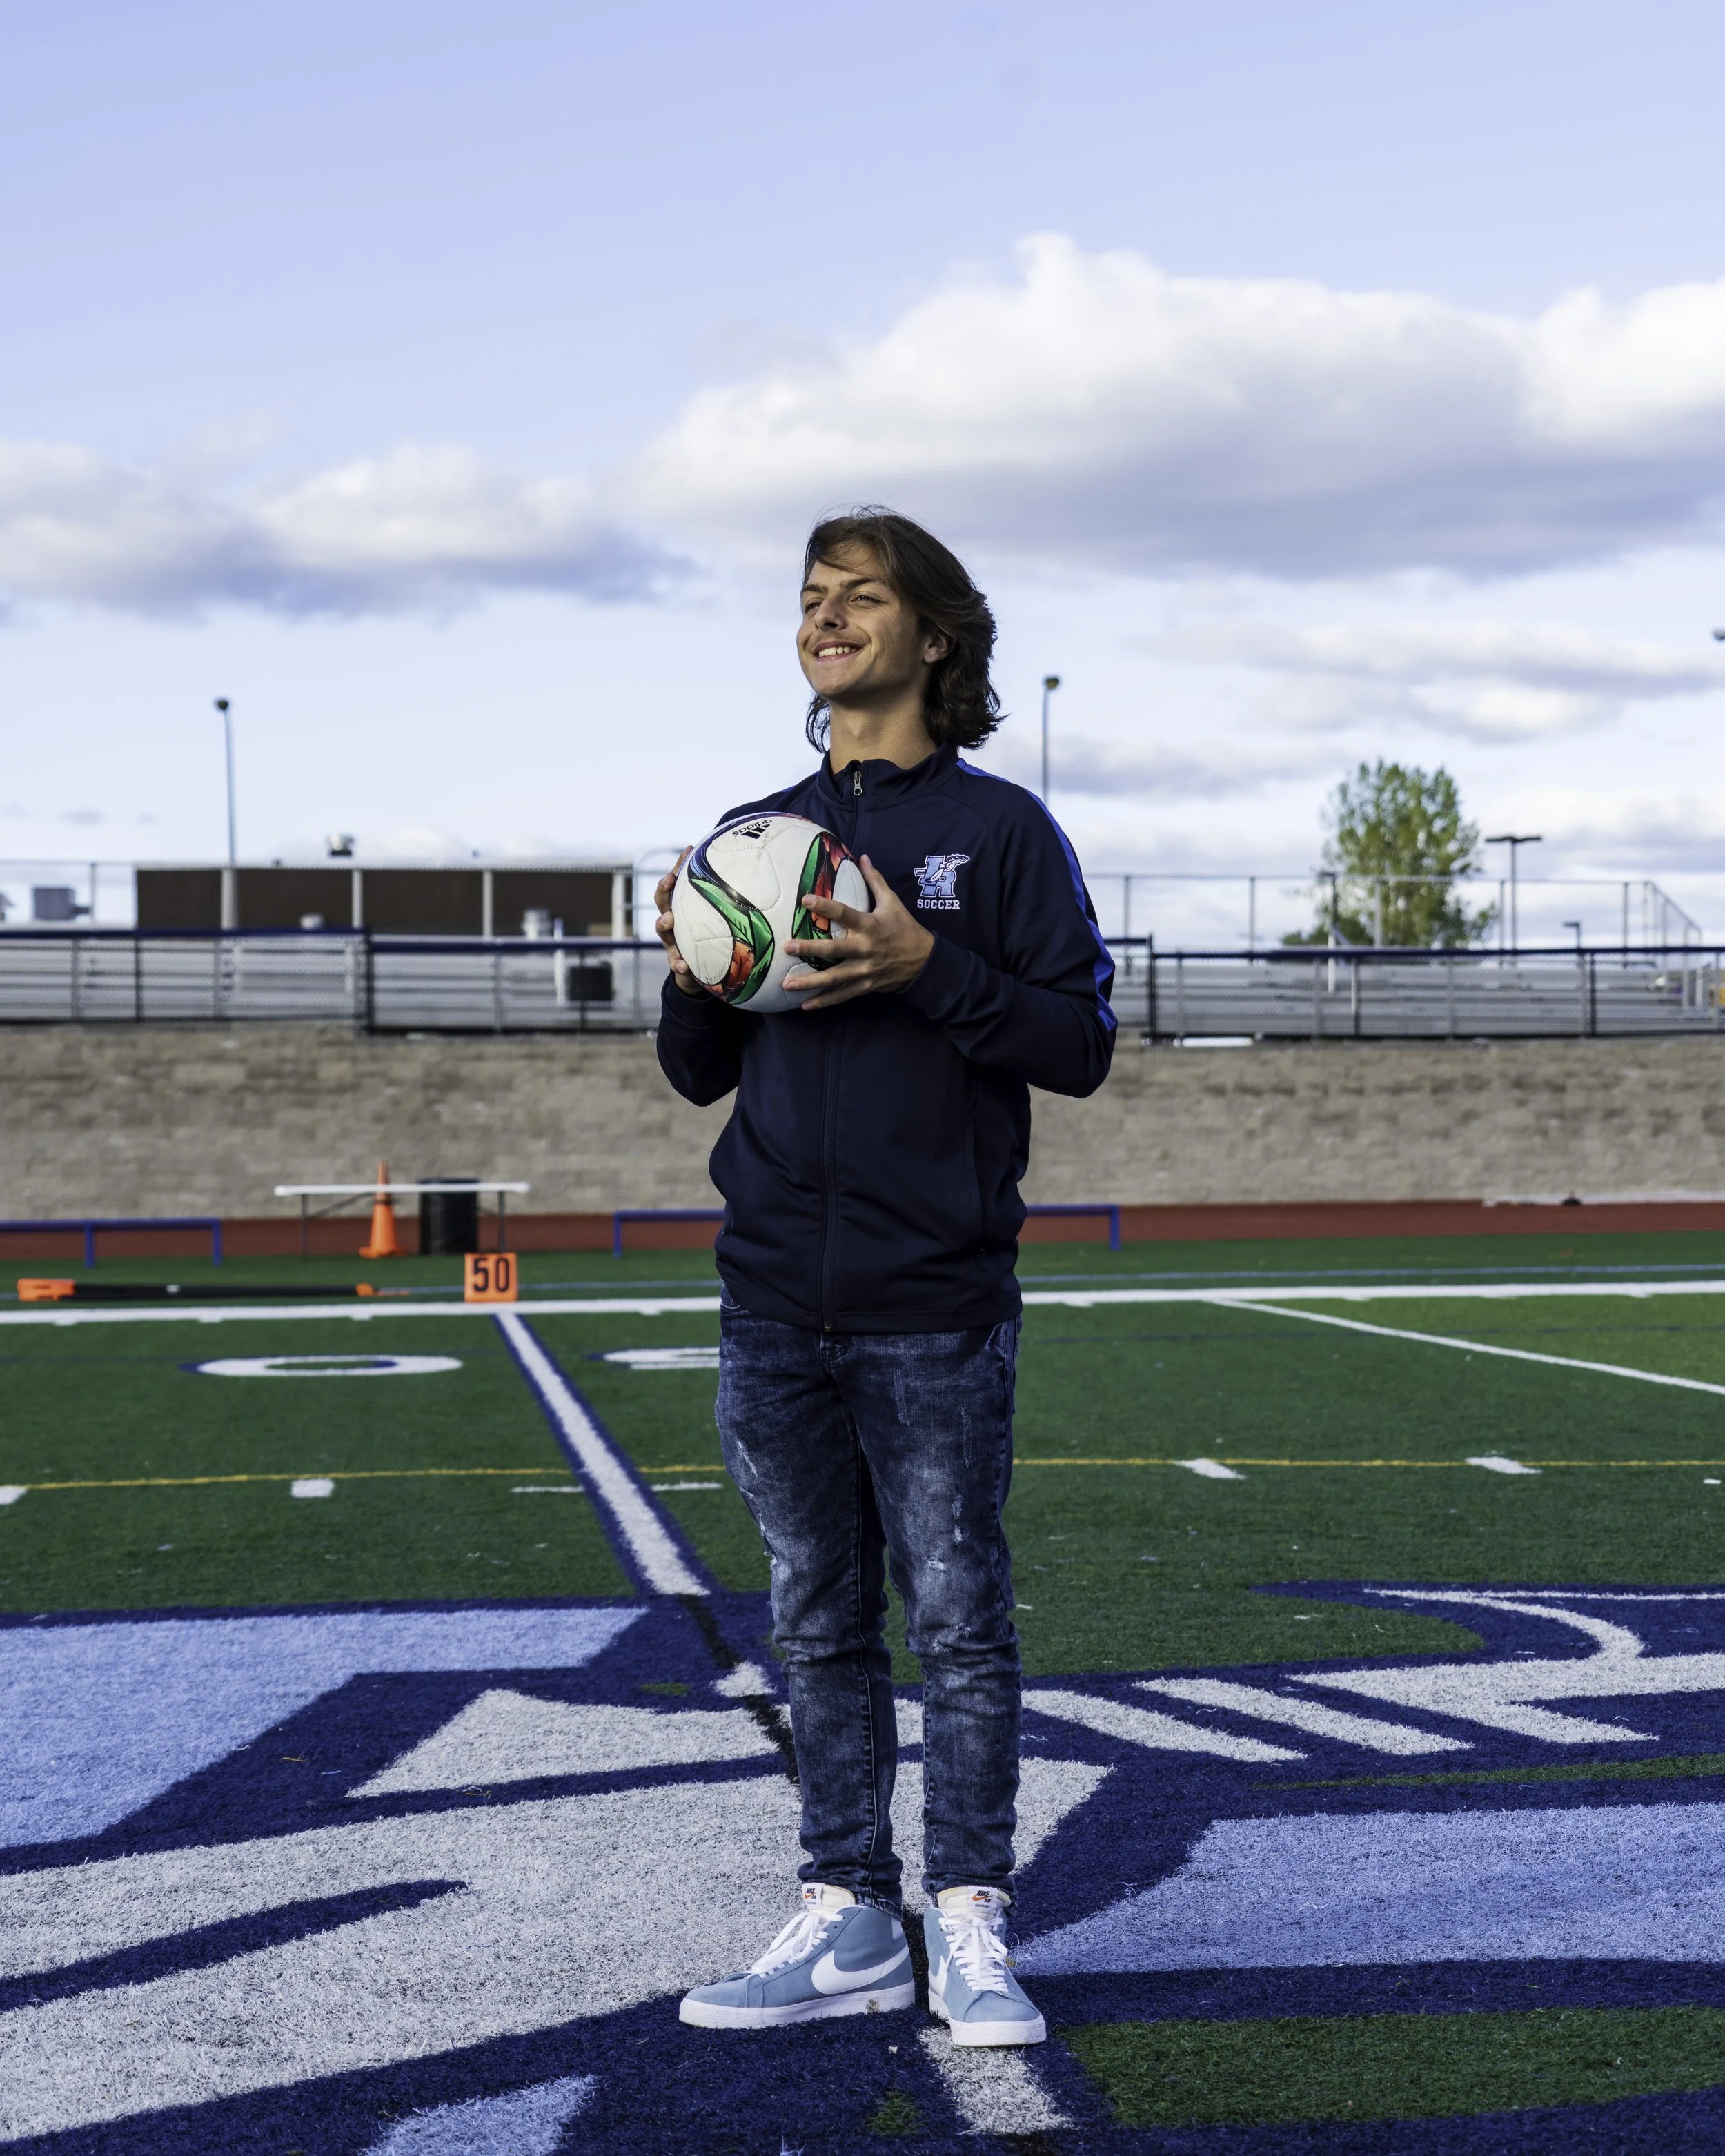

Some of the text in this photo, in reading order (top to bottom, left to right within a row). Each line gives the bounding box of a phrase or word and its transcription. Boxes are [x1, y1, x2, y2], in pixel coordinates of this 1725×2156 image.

[732, 819, 772, 835] adidas
[917, 898, 960, 909] SOCCER
[473, 1257, 509, 1292] 50
